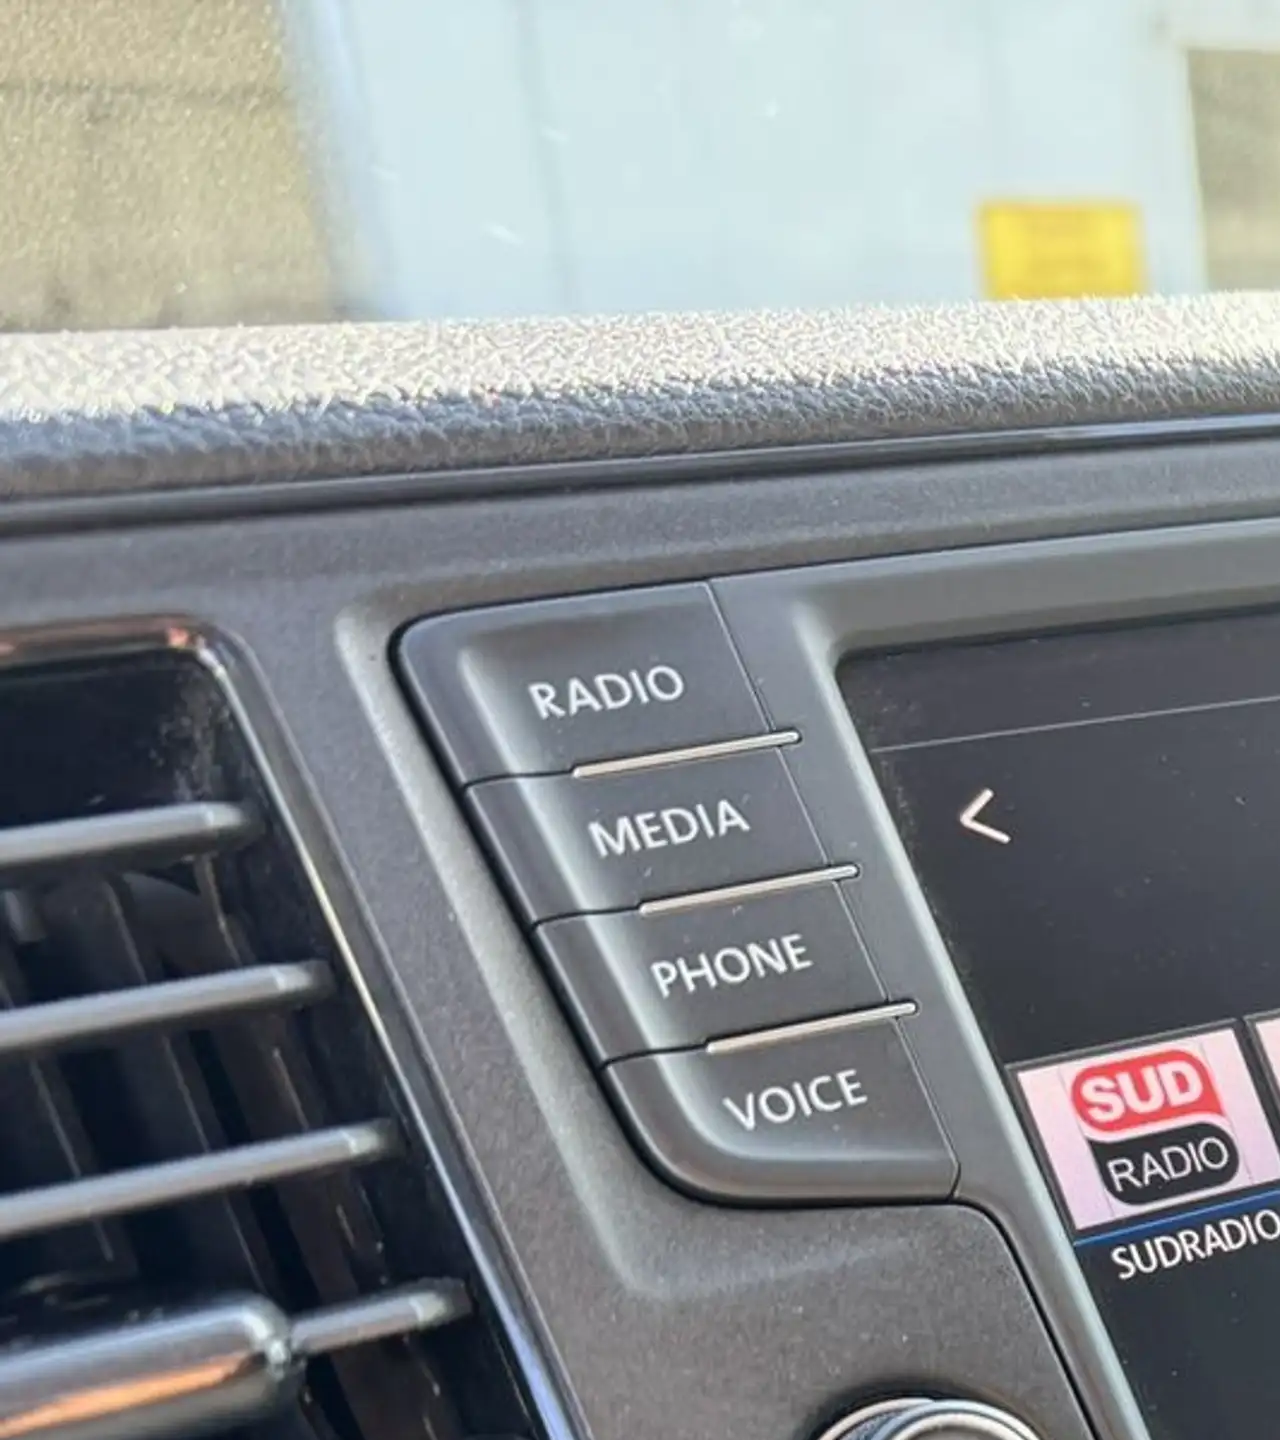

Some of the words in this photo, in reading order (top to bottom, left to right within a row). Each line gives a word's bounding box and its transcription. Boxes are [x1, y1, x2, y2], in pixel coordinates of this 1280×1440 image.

[528, 665, 685, 721] RADIO
[588, 799, 750, 857] MEDIA
[650, 934, 813, 998] PHONE
[724, 1069, 867, 1132] VOICE
[1080, 1062, 1204, 1122] SUD
[1107, 1138, 1229, 1193] RADIO
